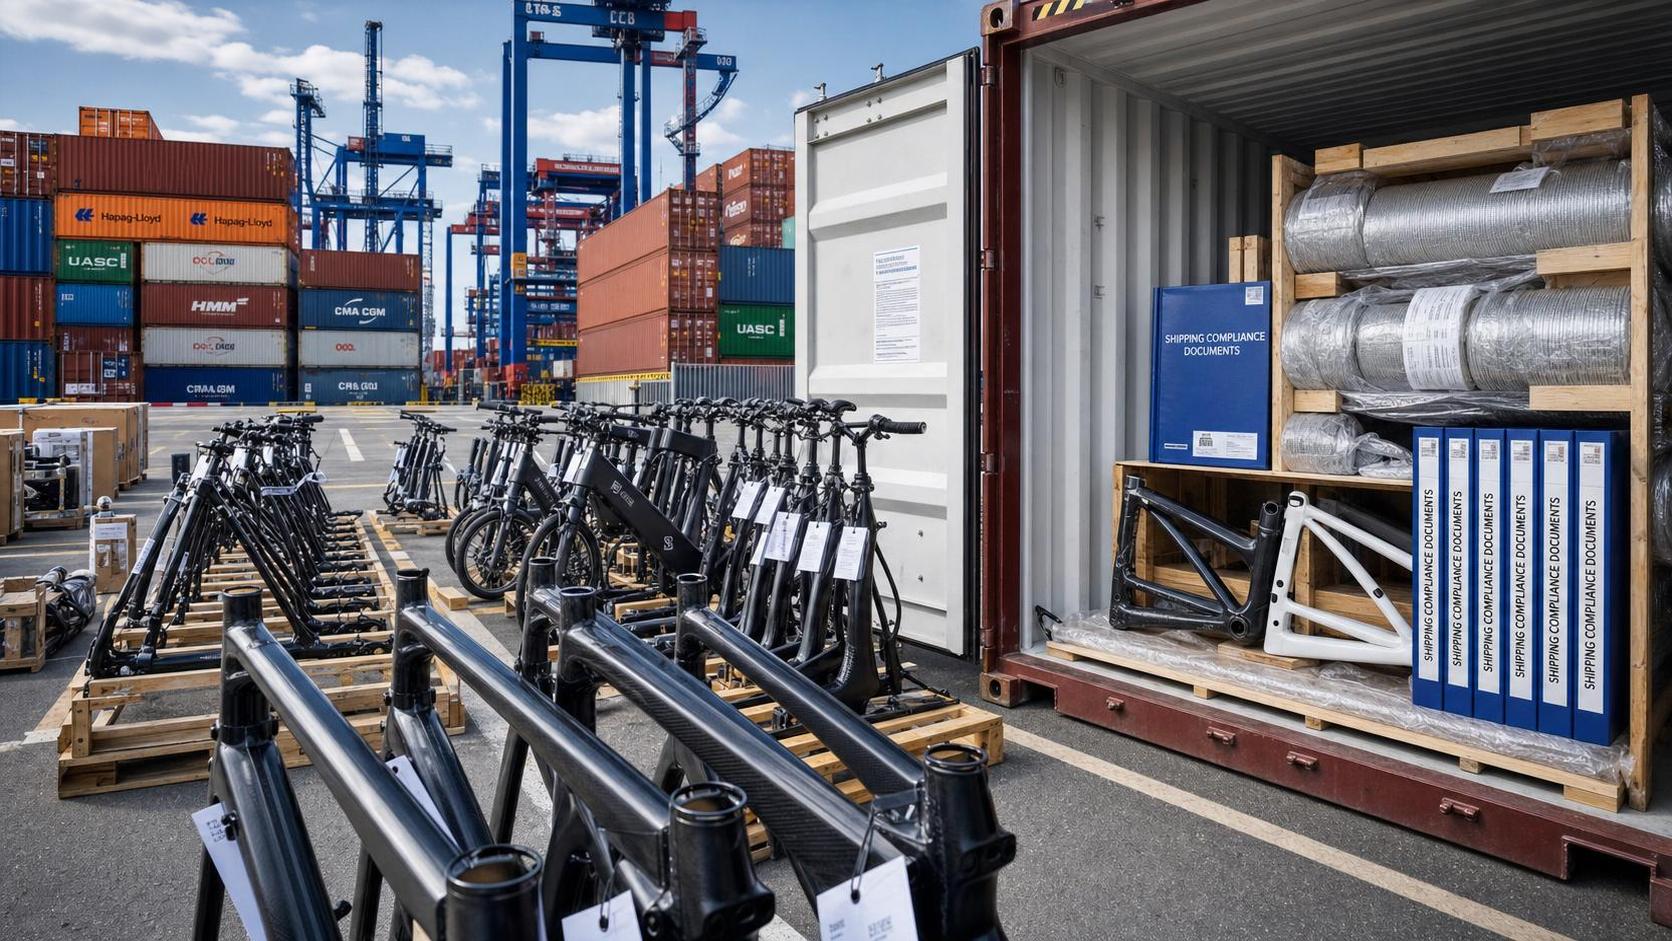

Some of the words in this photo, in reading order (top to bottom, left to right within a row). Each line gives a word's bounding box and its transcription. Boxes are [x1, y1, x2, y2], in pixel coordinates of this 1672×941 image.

[101, 212, 161, 223] Hapag-Lloyd
[214, 216, 273, 228] Hapag-Lloyd
[68, 256, 118, 267] UASC
[191, 300, 237, 312] HMM
[334, 306, 359, 316] CMA
[361, 307, 386, 317] CGM
[737, 323, 775, 335] UASC
[1165, 333, 1204, 344] SHIPPING
[1206, 331, 1266, 343] COMPLIANCE
[1183, 345, 1240, 356] DOCUMENTS
[1423, 489, 1434, 549] DOCUMENTS
[1452, 491, 1463, 552] DOCUMENTS
[1483, 493, 1494, 556] DOCUMENTS
[1515, 495, 1526, 558] DOCUMENTS
[1549, 497, 1561, 562] DOCUMENTS
[1584, 500, 1597, 566] DOCUMENTS
[1423, 551, 1434, 616] COMPLIANCE
[1452, 555, 1463, 620] COMPLIANCE
[1483, 558, 1494, 624] COMPLIANCE
[1514, 561, 1526, 628] COMPLIANCE
[1548, 565, 1560, 634] COMPLIANCE
[1584, 568, 1597, 639] COMPLIANCE
[1423, 618, 1434, 662] SHIPPING
[1452, 622, 1463, 667] SHIPPING
[1483, 627, 1494, 673] SHIPPING
[1514, 632, 1526, 678] SHIPPING
[1548, 636, 1560, 684] SHIPPING
[1583, 641, 1597, 690] SHIPPING
